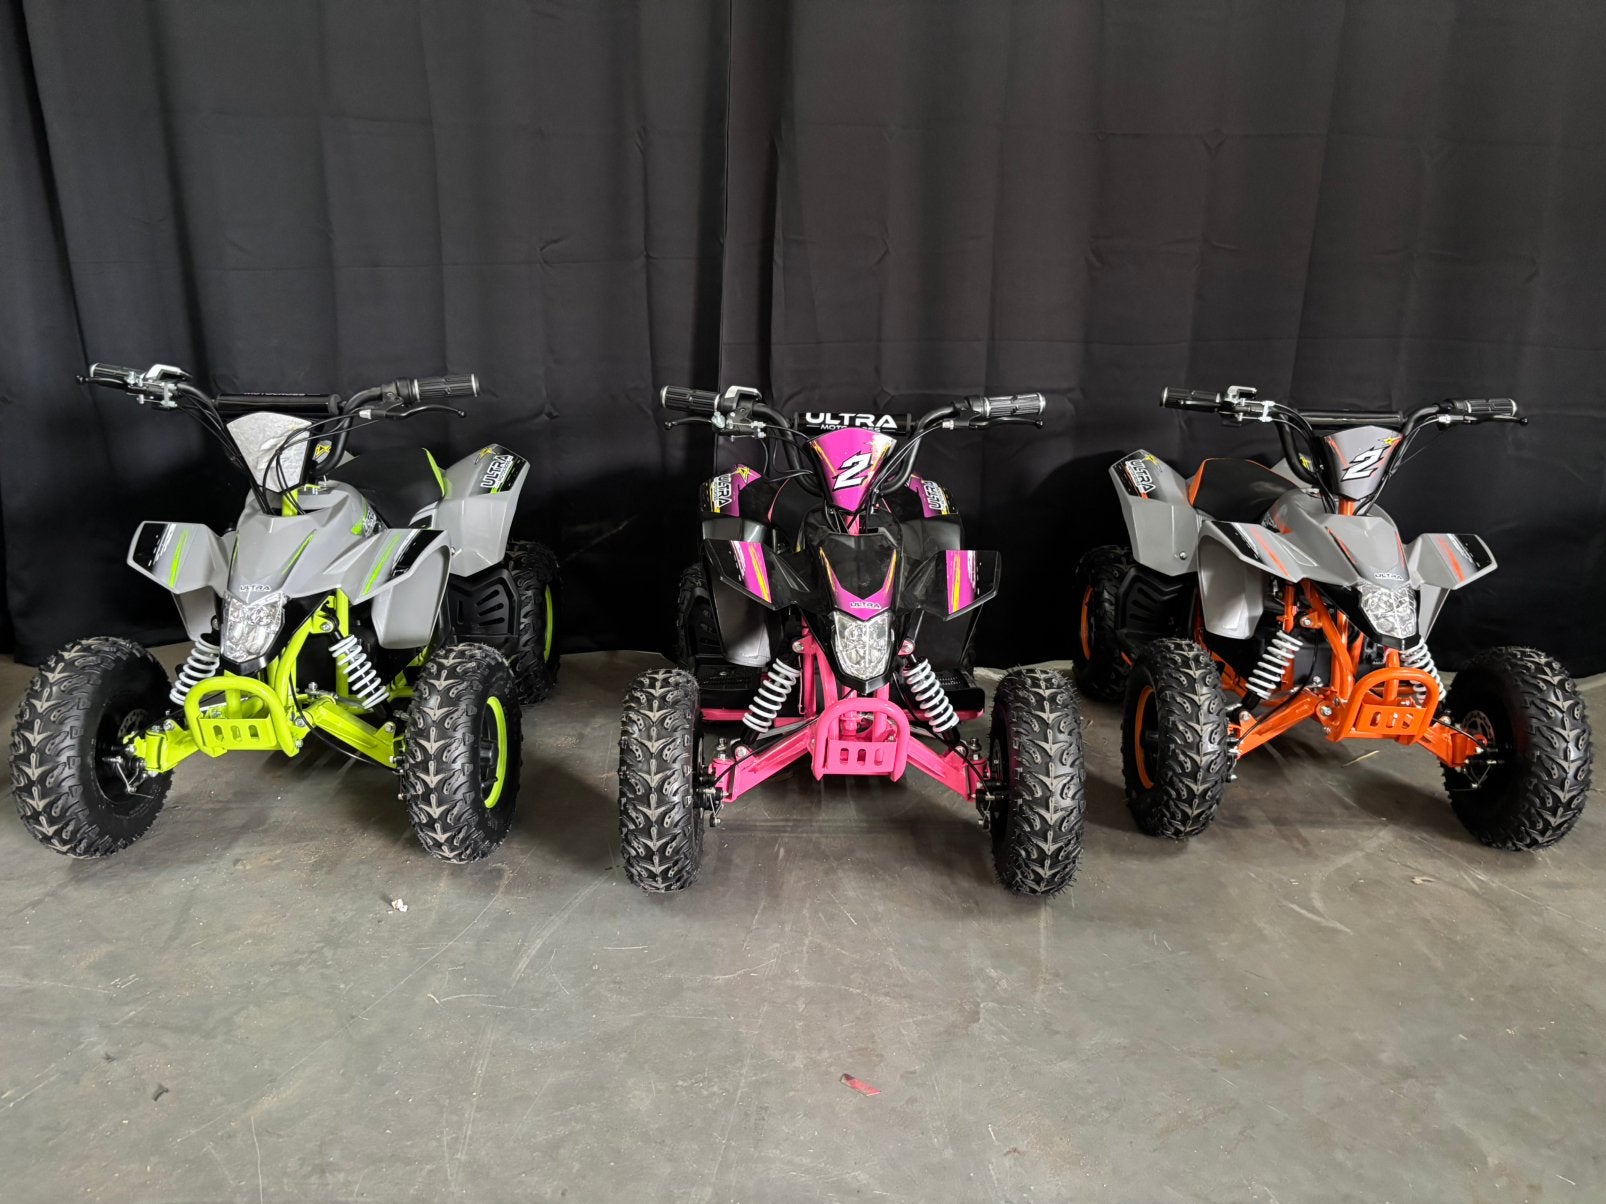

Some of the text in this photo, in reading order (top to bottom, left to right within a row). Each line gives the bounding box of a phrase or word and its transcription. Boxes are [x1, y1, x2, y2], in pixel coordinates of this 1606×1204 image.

[805, 412, 898, 429] ULTRA
[480, 455, 509, 487] ULTRA
[832, 451, 873, 491] 2
[1127, 459, 1156, 493] ULTRA
[1341, 446, 1388, 482] 2
[717, 474, 732, 508] ULTRA
[239, 583, 272, 593] ULTRA
[1373, 572, 1405, 582] ULTRA
[849, 601, 882, 610] ULTRA
